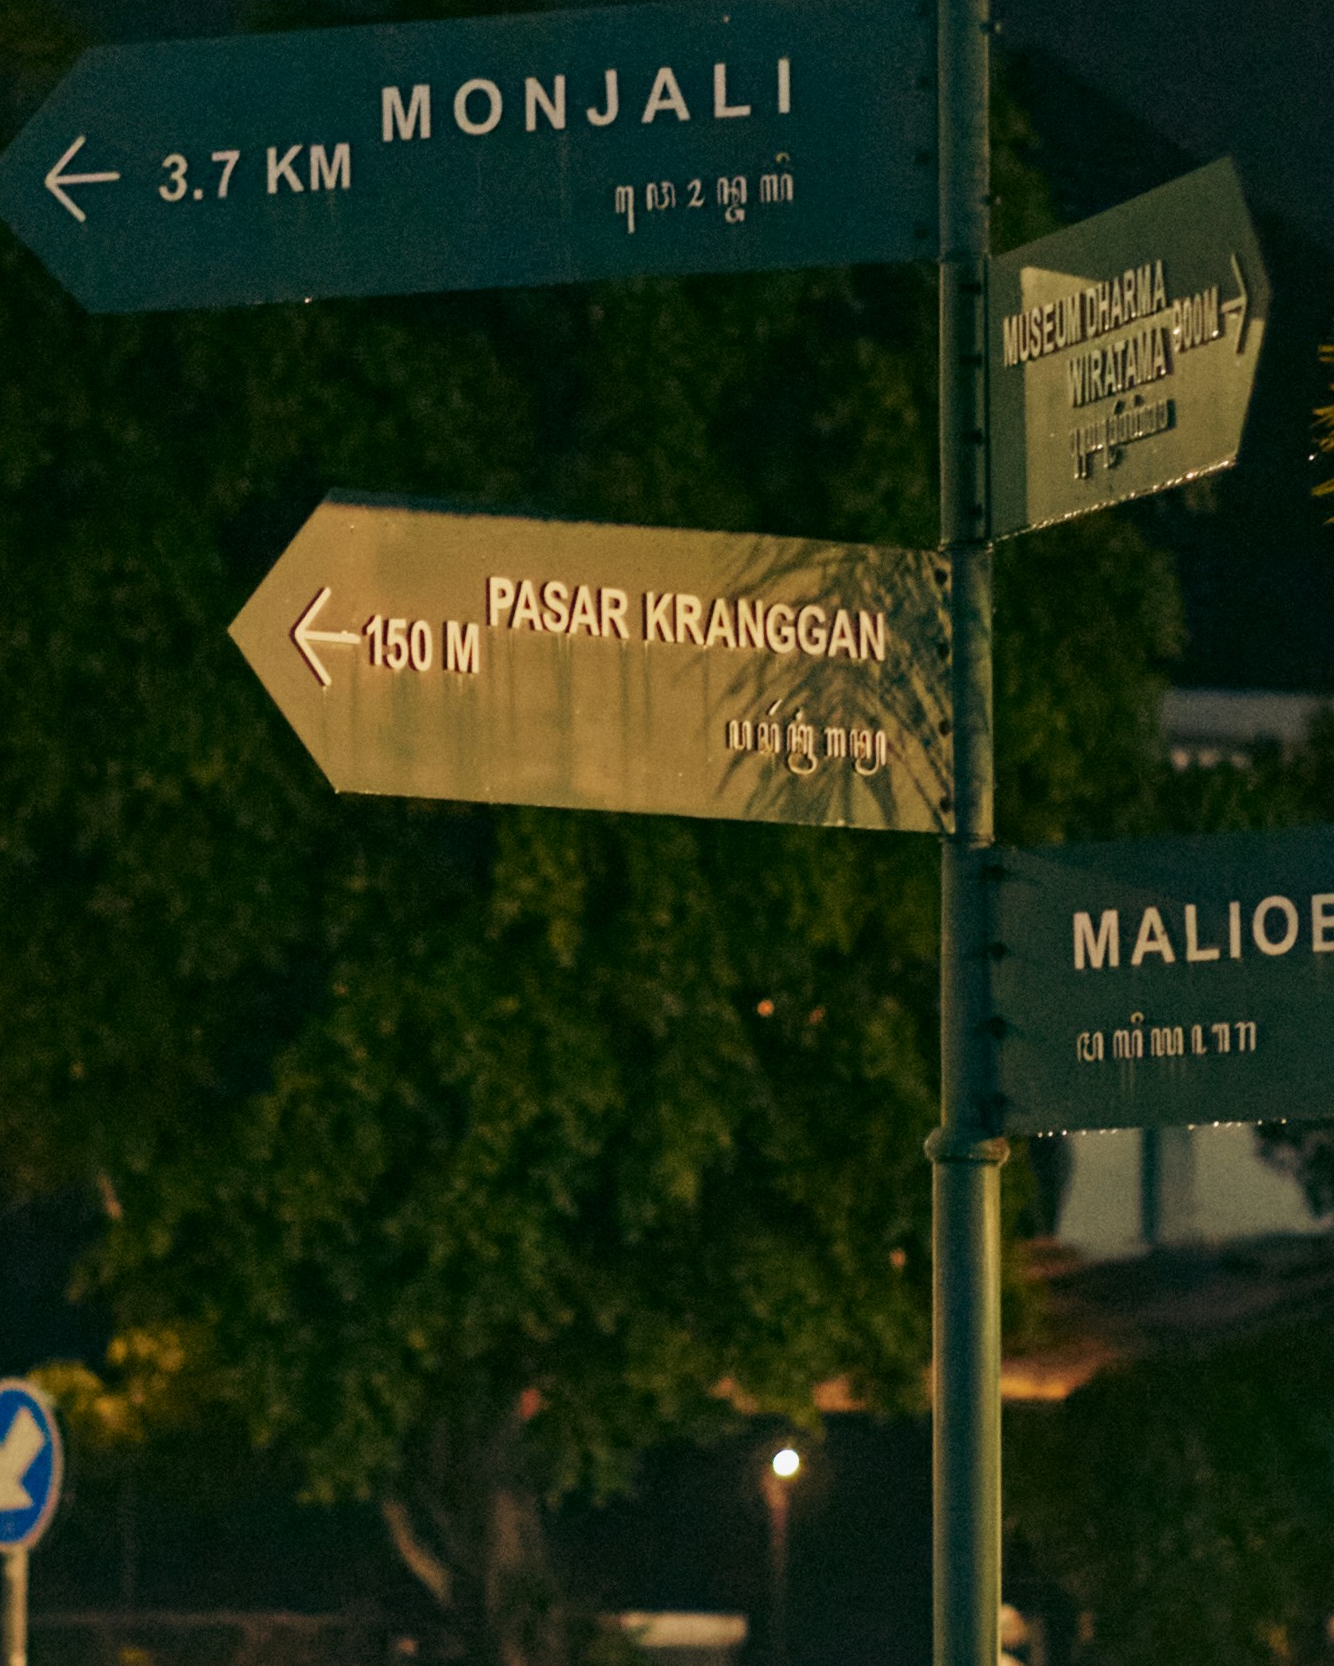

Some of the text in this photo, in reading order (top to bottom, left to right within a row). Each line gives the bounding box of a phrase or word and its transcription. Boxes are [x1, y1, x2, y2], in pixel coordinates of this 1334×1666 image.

[380, 57, 791, 143] MONJALI
[157, 141, 352, 202] 3.7 KM
[1003, 258, 1166, 369] MUSEUM DHARMA
[1069, 326, 1166, 408] WIRATAMA
[366, 615, 480, 673] 150 M
[488, 576, 885, 661] PASAR KRANGGAN
